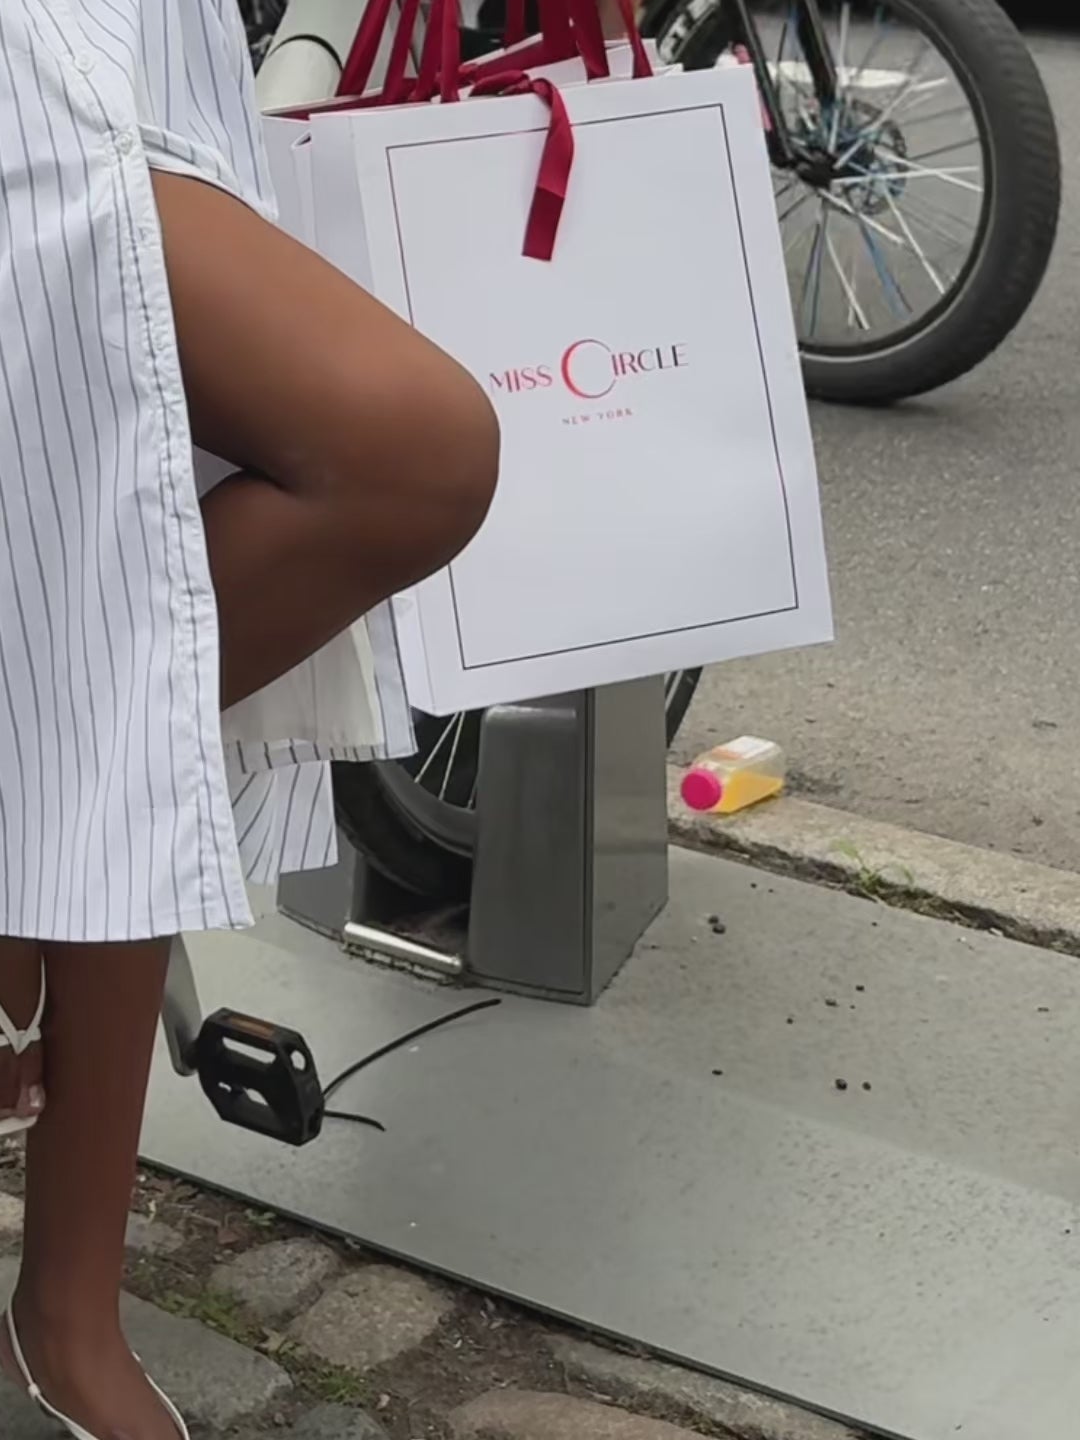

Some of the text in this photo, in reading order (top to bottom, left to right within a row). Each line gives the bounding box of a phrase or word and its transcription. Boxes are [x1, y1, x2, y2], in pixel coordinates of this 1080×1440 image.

[489, 338, 690, 399] MISS CIRCLE
[561, 407, 634, 426] NEW YORK
